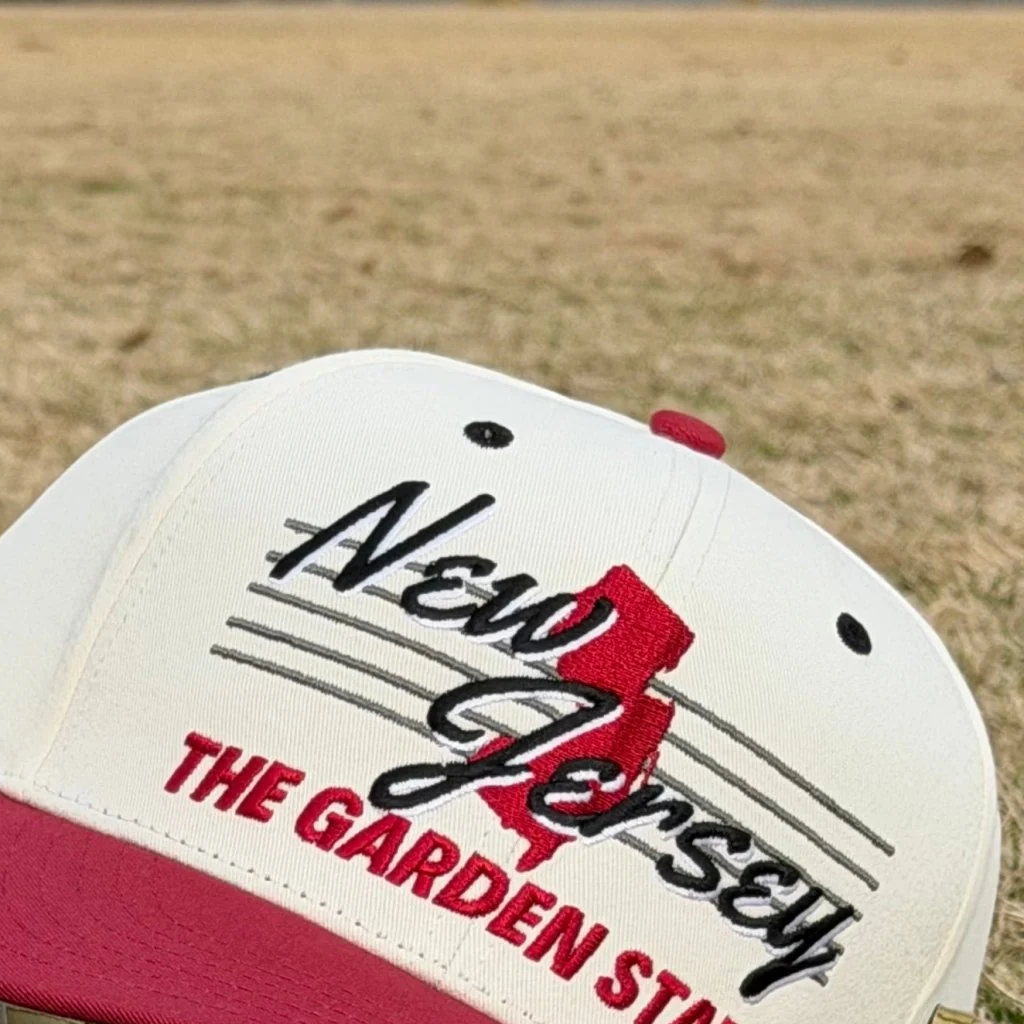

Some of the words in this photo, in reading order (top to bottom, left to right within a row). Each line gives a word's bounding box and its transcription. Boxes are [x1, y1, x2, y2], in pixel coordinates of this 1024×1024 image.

[269, 480, 617, 659] New
[163, 731, 305, 823] THE
[294, 786, 610, 981] GARDEN
[368, 675, 860, 1001] Jersey
